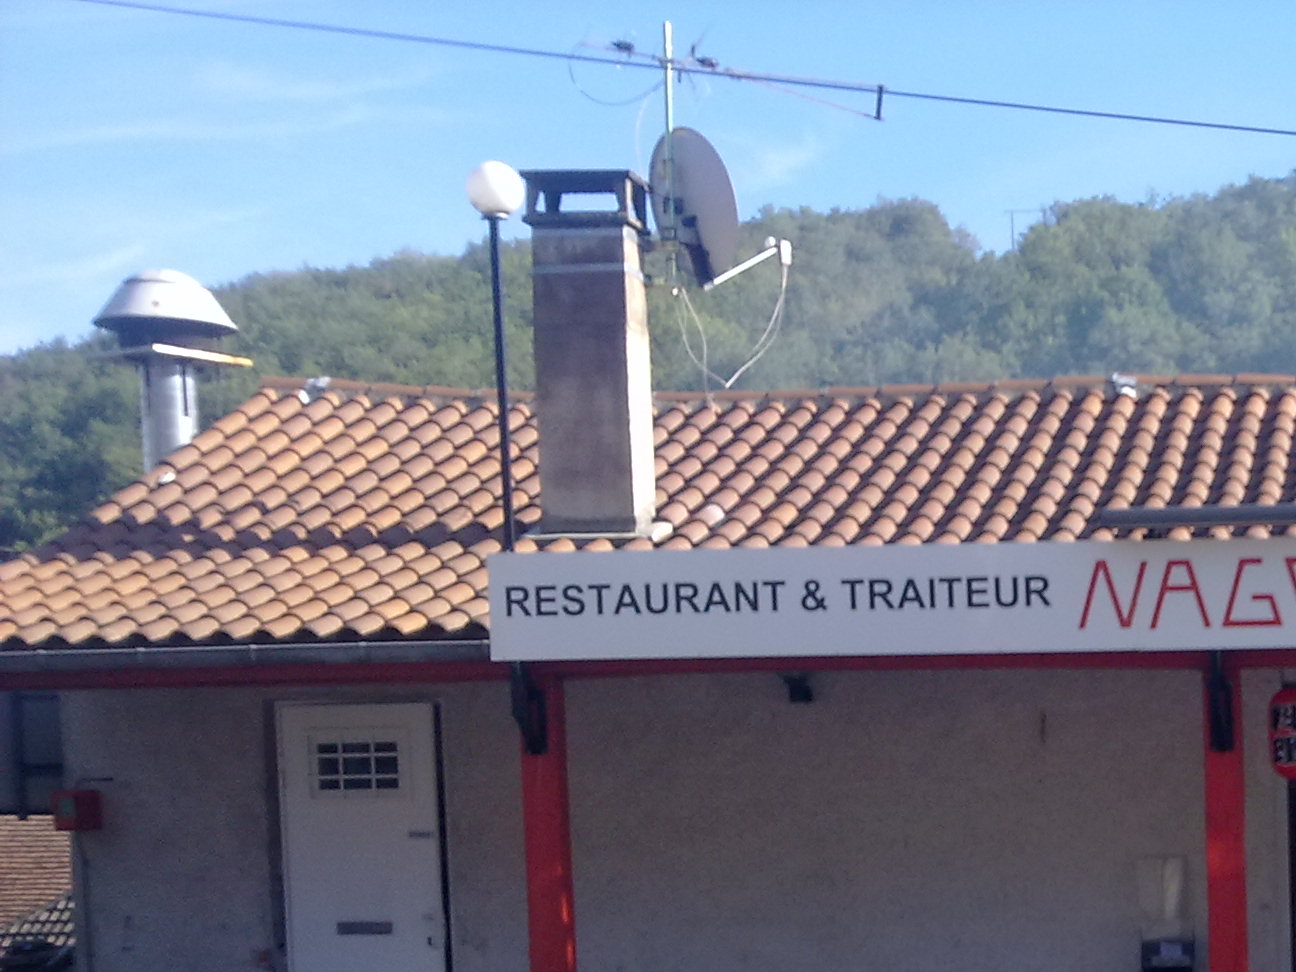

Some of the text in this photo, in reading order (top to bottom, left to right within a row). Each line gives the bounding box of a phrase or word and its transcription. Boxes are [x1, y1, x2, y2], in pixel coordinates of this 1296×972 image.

[504, 579, 787, 618] RESTAURANT
[799, 578, 829, 612] &
[840, 574, 1052, 611] TRAITEUR
